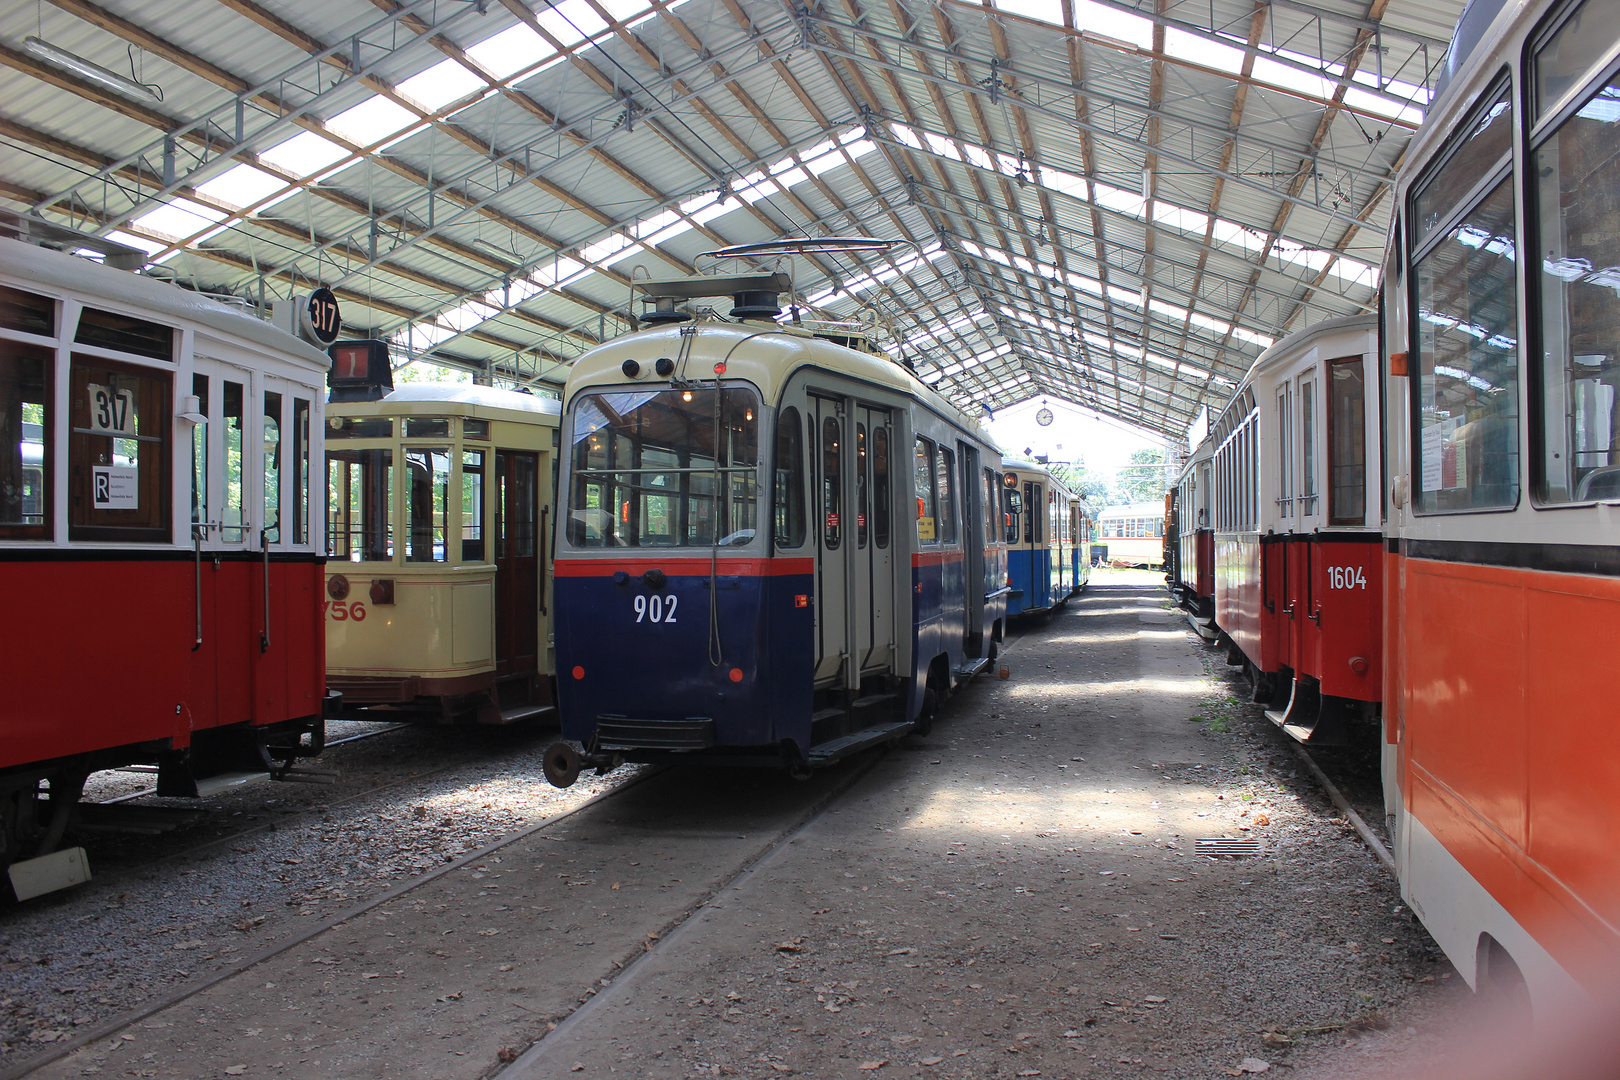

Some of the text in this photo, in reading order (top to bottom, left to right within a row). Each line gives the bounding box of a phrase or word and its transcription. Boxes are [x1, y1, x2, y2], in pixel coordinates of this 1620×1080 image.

[312, 298, 336, 332] 317
[349, 352, 356, 378] 1
[96, 391, 128, 431] 317
[96, 475, 109, 499] R
[1327, 566, 1367, 590] 1604
[634, 594, 678, 623] 902
